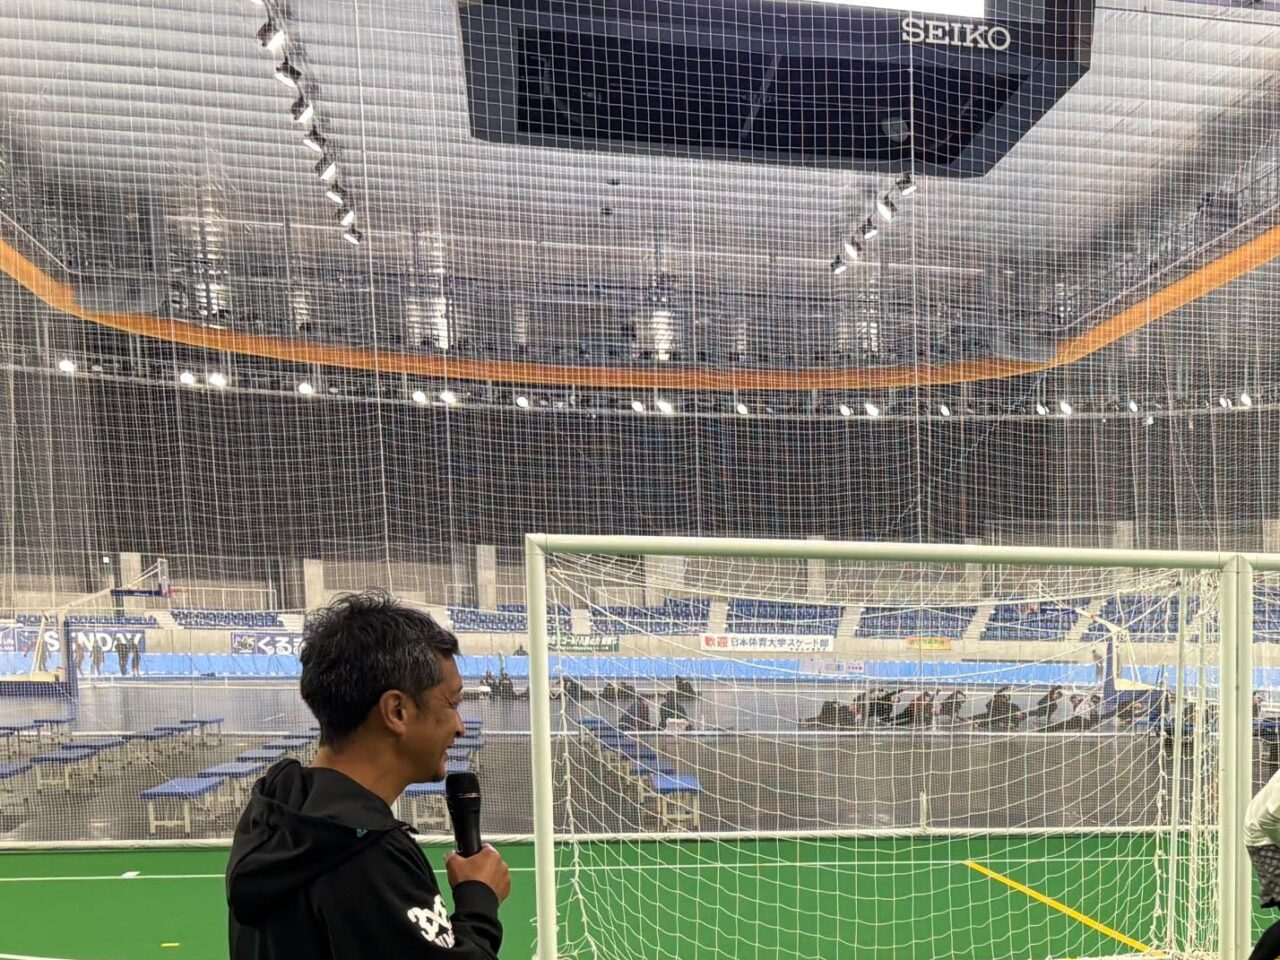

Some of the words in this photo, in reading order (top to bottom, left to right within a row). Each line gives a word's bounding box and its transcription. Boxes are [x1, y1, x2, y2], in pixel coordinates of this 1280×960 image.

[901, 17, 1011, 51] SEIKO
[44, 630, 142, 652] SNDAY
[731, 636, 829, 649] 日本体育大学スケート部
